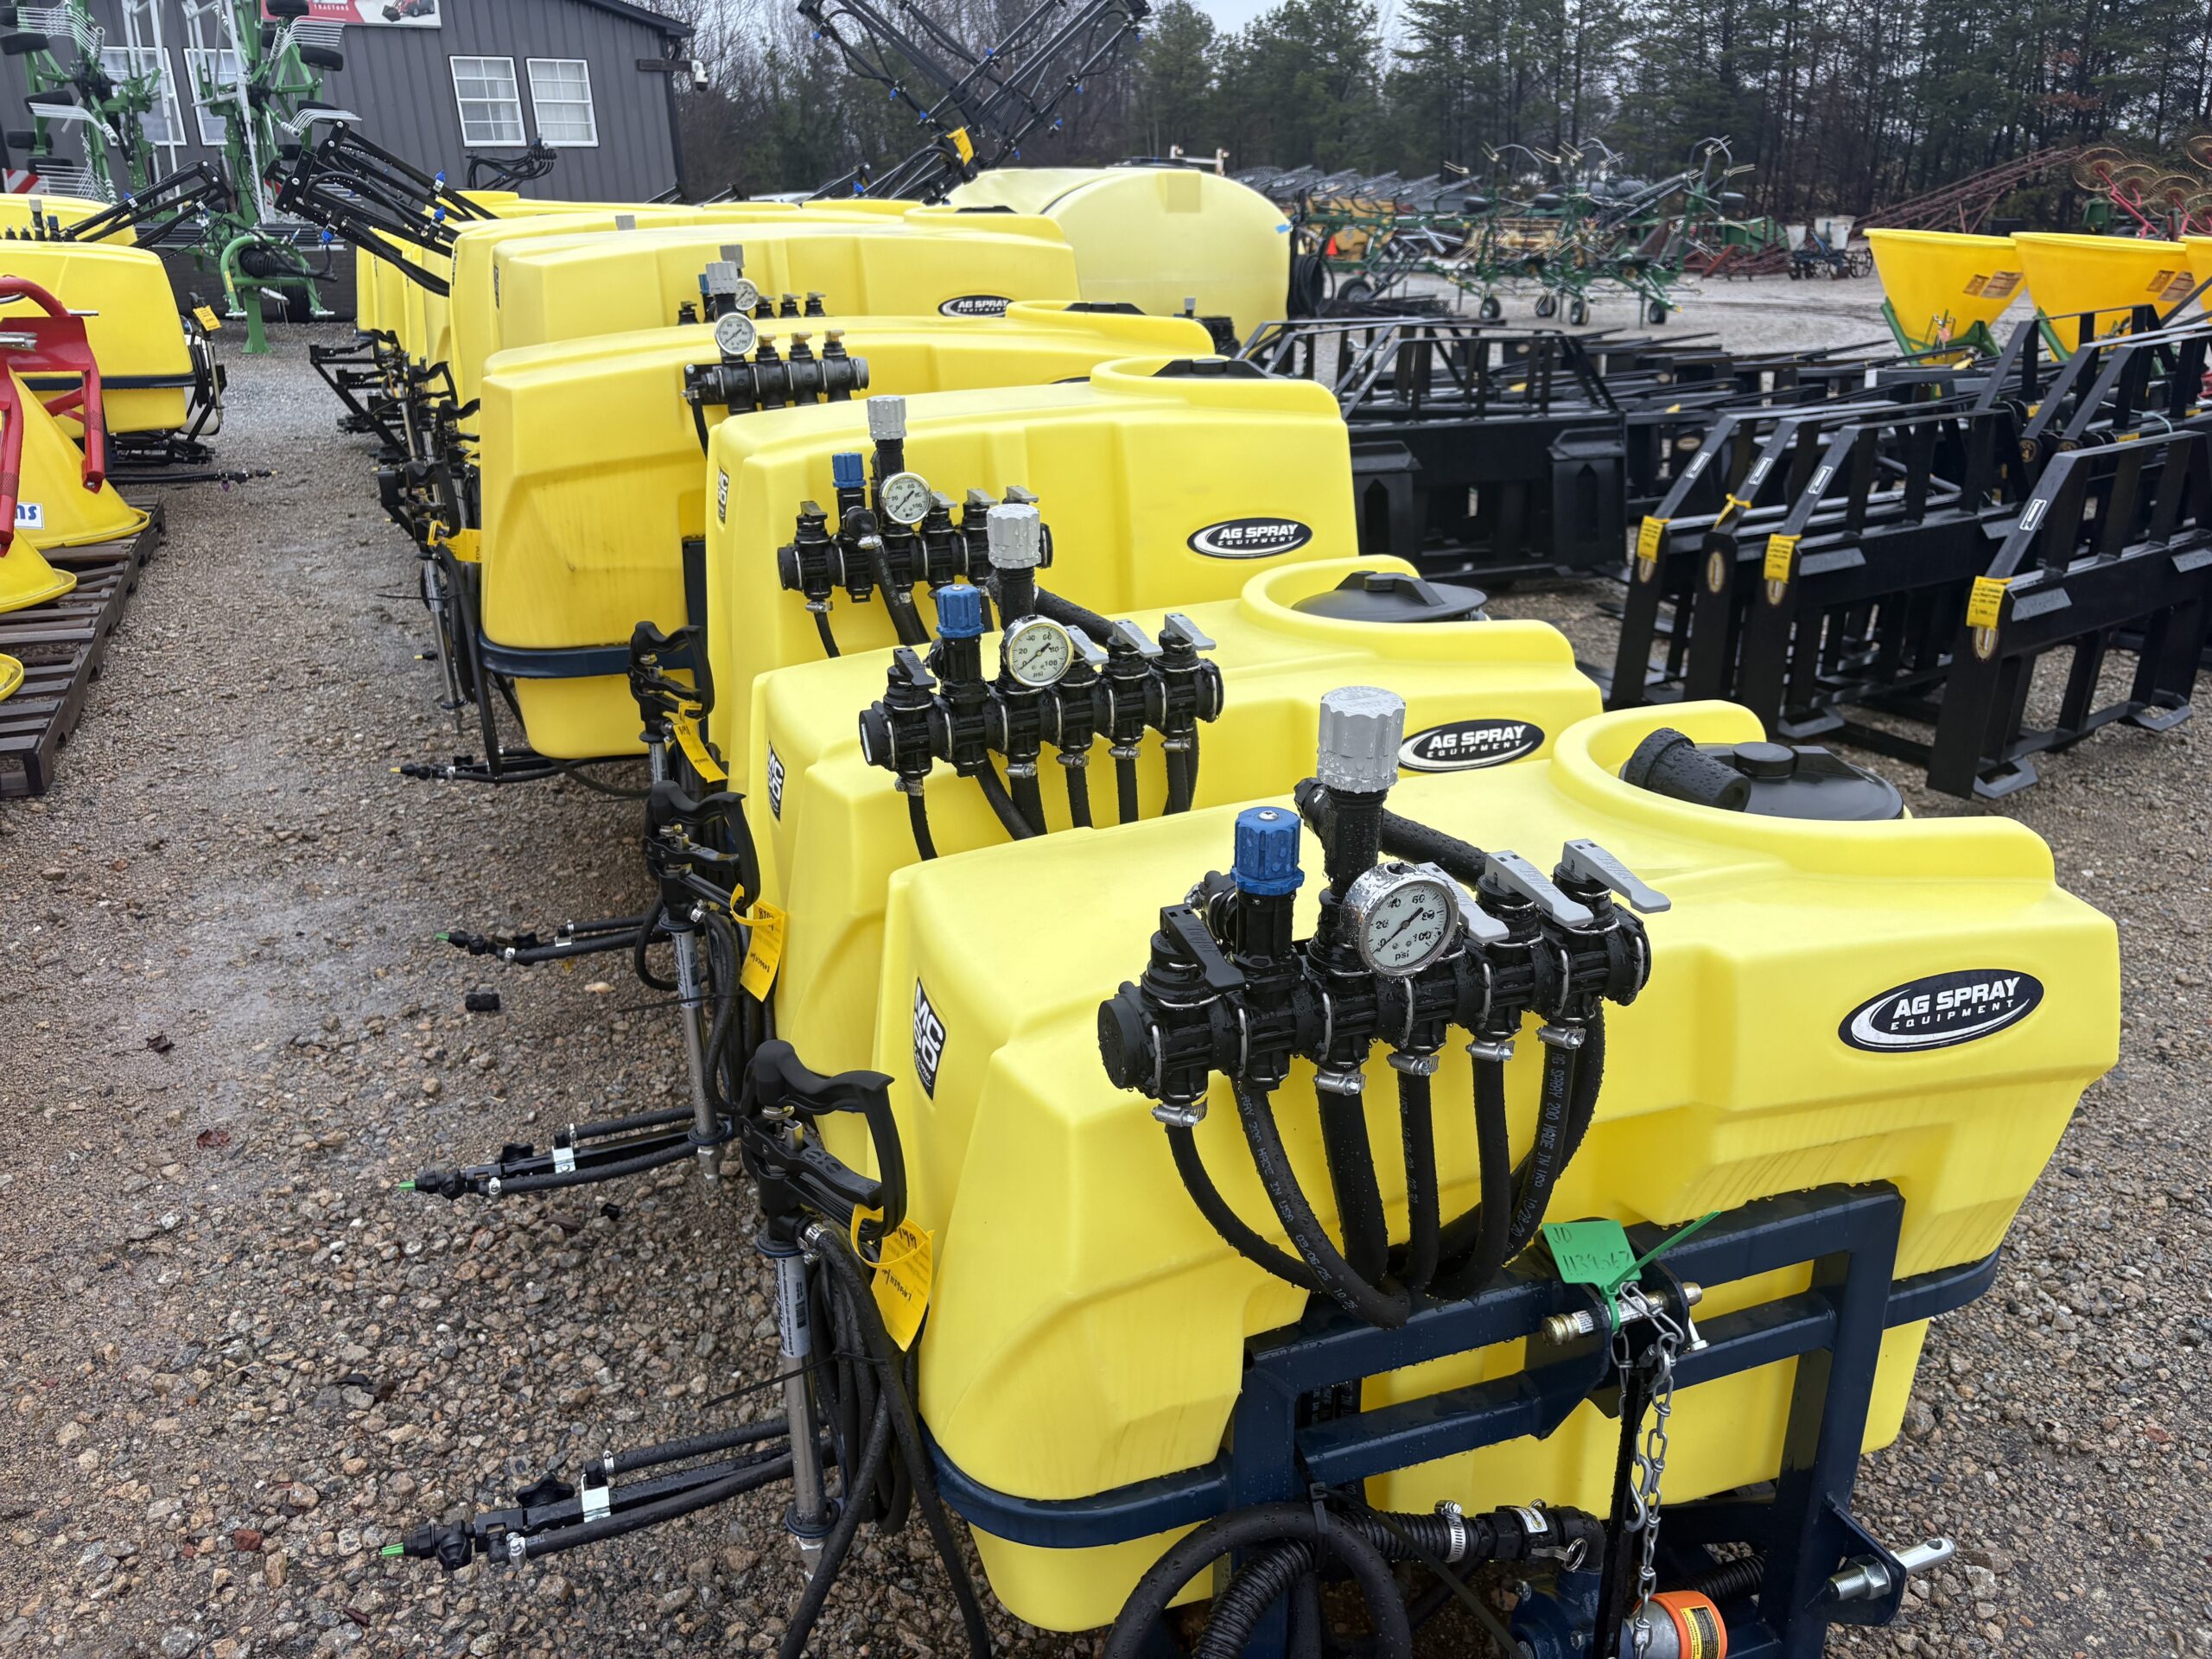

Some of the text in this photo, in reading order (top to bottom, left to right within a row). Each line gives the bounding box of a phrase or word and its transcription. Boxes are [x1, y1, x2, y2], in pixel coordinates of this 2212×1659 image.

[975, 299, 1009, 308] SPRAY
[1218, 524, 1299, 540] AG SPRAY
[1217, 536, 1294, 546] EQUIPMENT
[1428, 725, 1527, 750] AG SPRAY
[1427, 740, 1522, 758] EQUIPMENT
[1388, 897, 1402, 908] 40
[1412, 894, 1426, 904] 60
[1421, 909, 1435, 921] 80
[1376, 918, 1389, 930] 20
[1413, 931, 1432, 942] 100
[1395, 950, 1409, 961] psi
[1892, 976, 2020, 1019] AG SPRAY
[1890, 999, 2014, 1031] EQUIPMENT
[1548, 1070, 1565, 1097] SPRAY
[1546, 1103, 1561, 1121] 200
[1541, 1124, 1557, 1150] MADE
[1538, 1153, 1552, 1171] IN
[1256, 1147, 1274, 1175] MADE
[1268, 1181, 1282, 1196] IN
[1278, 1199, 1294, 1223] USA
